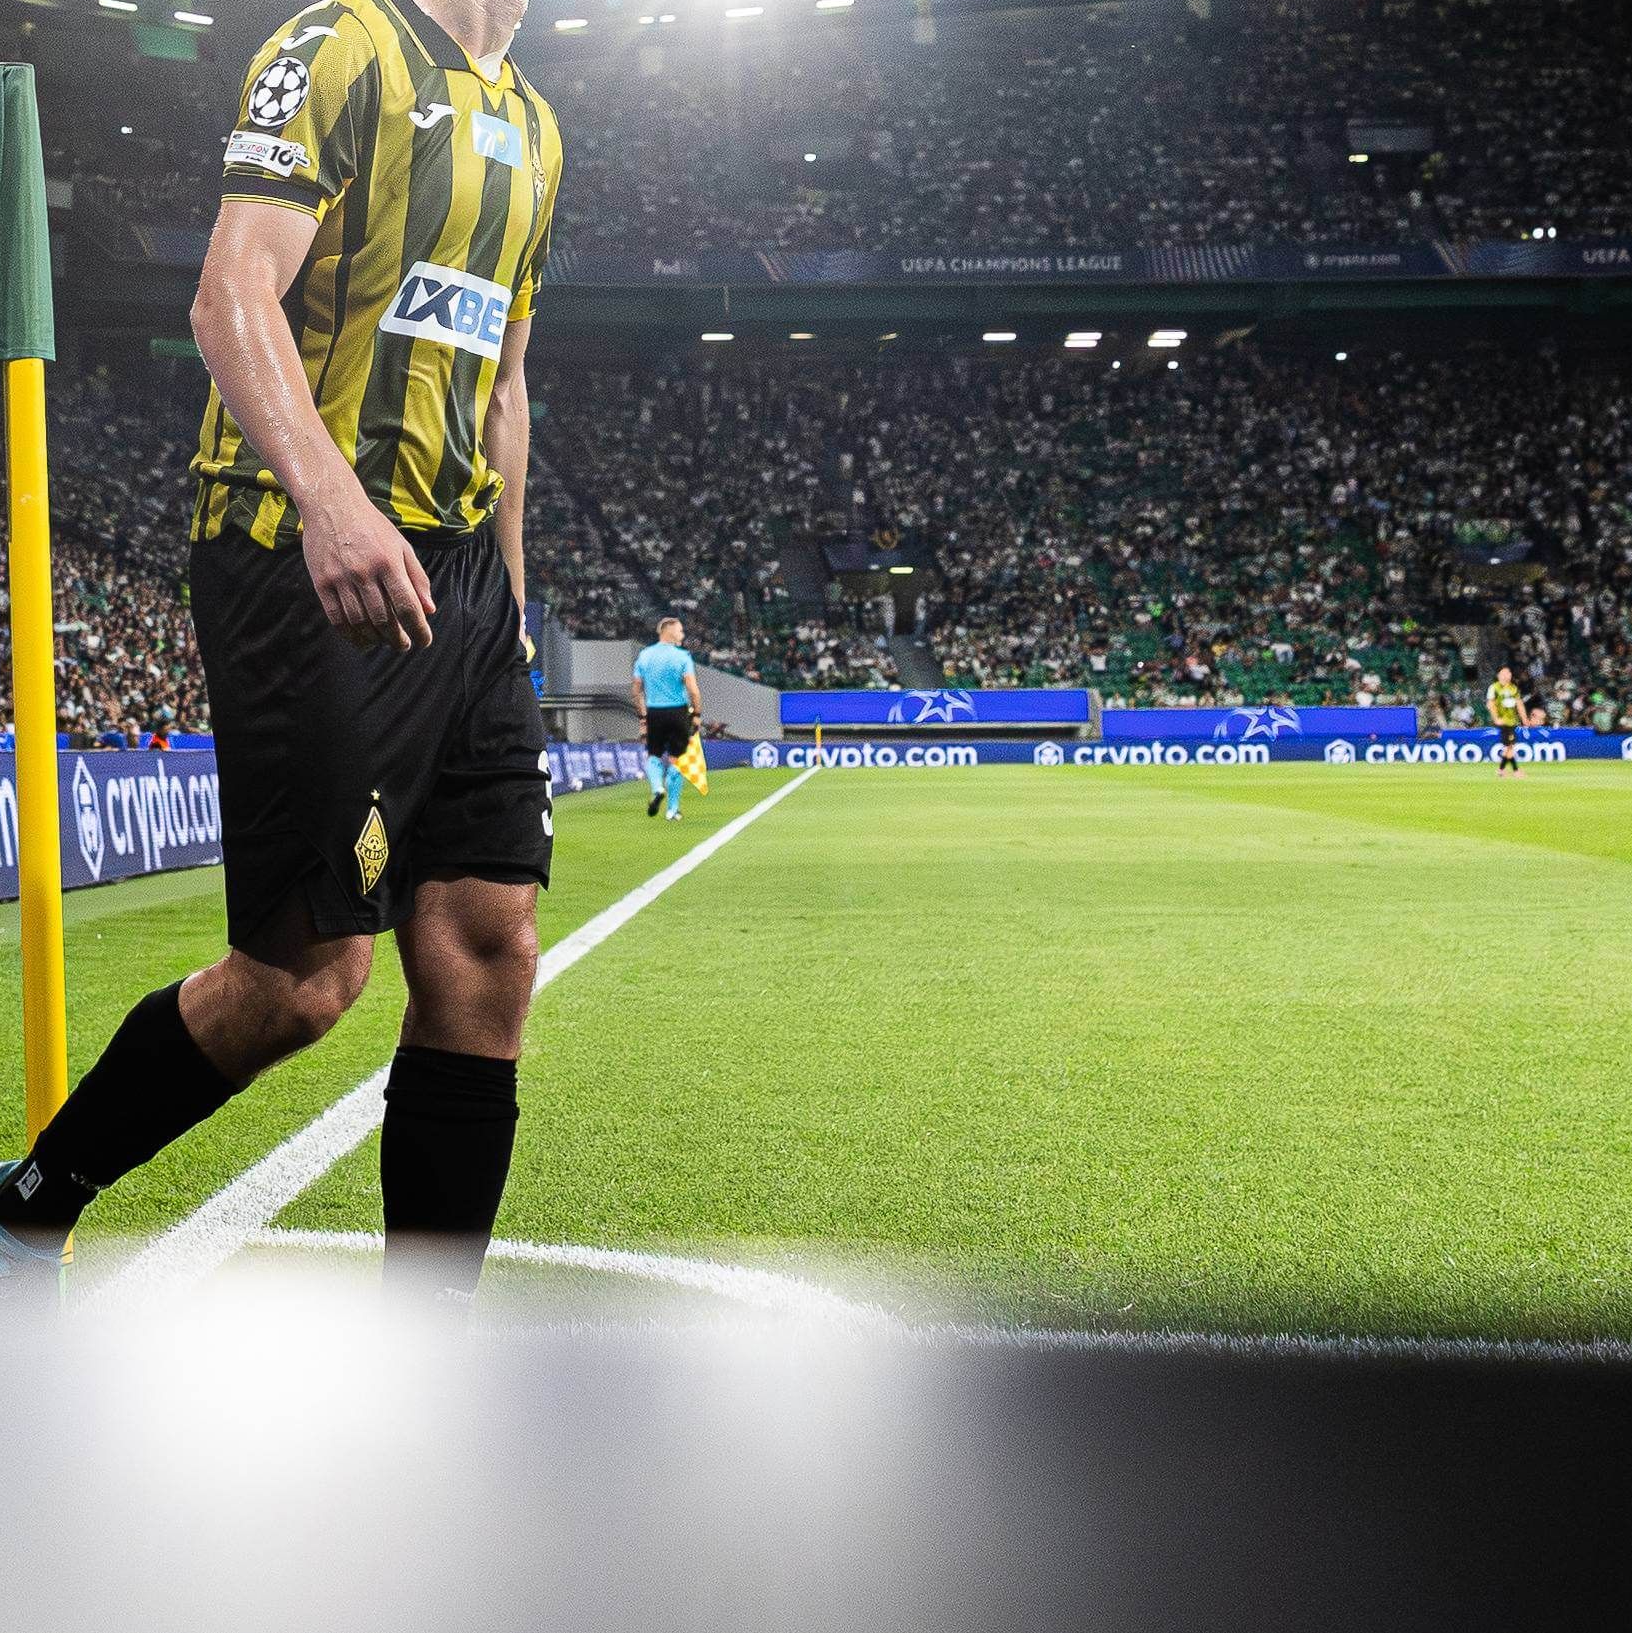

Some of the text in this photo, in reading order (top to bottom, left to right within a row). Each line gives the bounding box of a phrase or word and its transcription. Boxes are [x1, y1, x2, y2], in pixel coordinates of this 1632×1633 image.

[902, 254, 1122, 272] UEFA CHAMPIONS LEAGUE
[1582, 247, 1629, 265] UEFA
[786, 743, 979, 768] crypto.com
[1073, 740, 1270, 765] crypto.com
[106, 759, 222, 870] crypto.co
